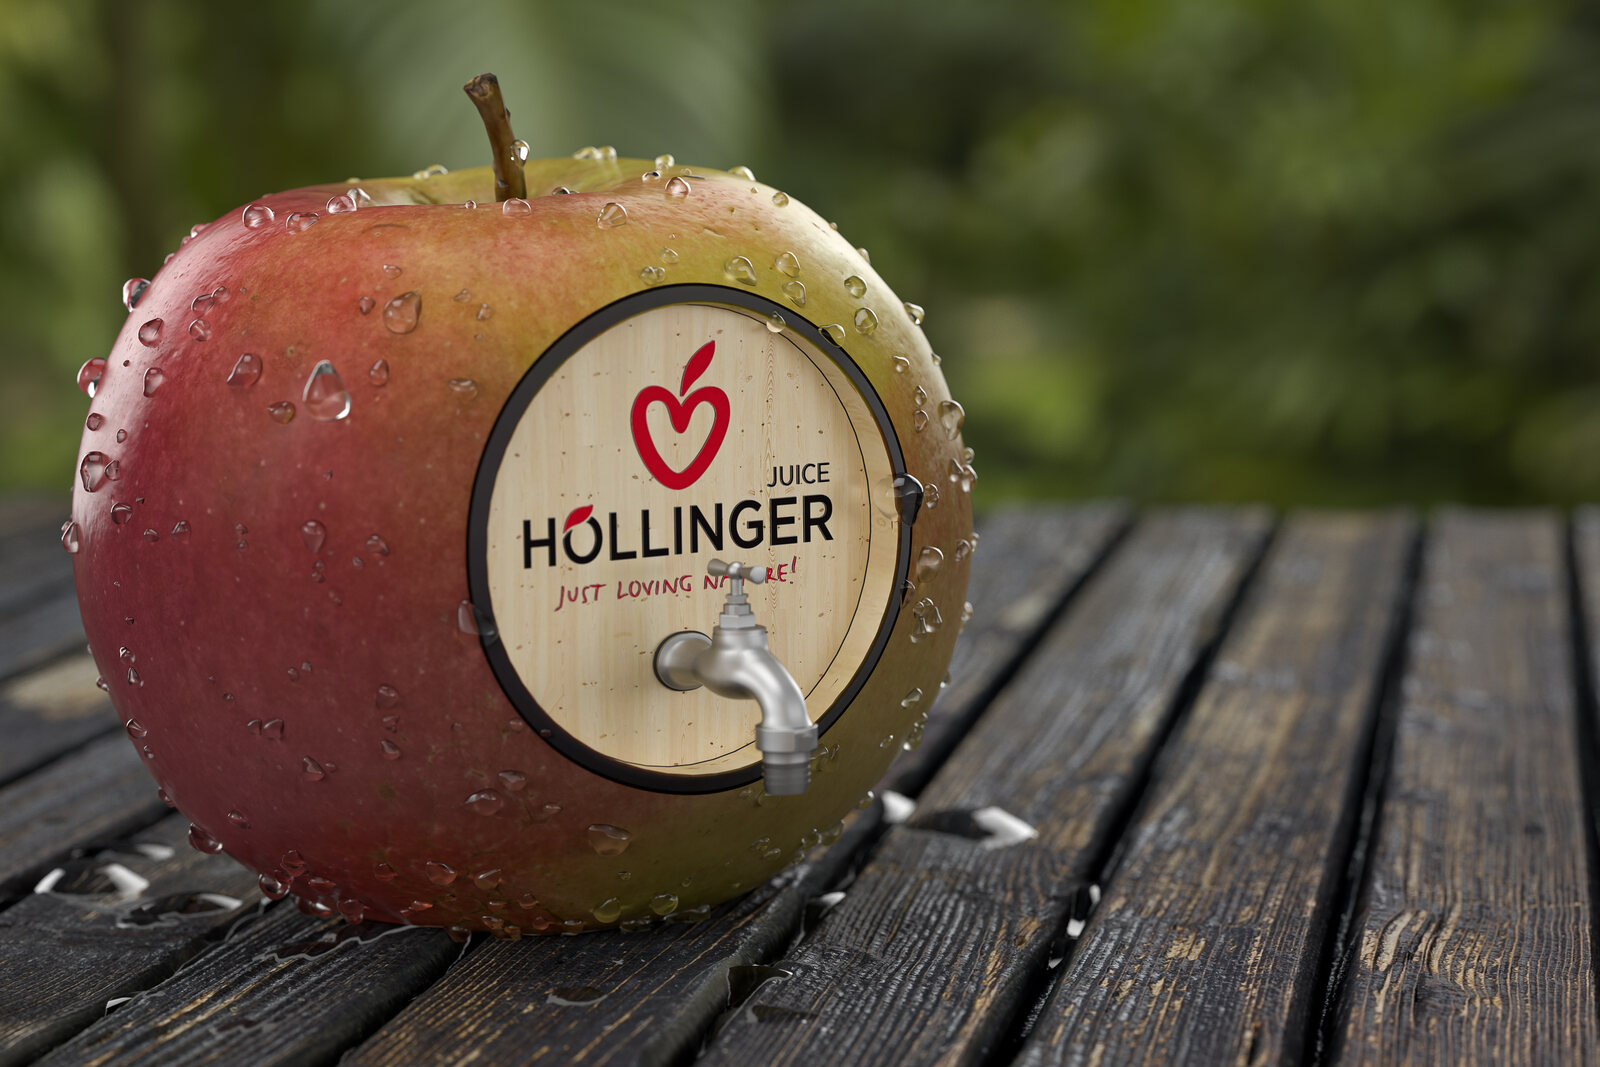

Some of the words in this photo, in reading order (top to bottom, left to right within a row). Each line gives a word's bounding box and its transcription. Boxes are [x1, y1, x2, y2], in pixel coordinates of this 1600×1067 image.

[767, 462, 830, 487] JUICE
[554, 584, 607, 611] JUST
[617, 575, 692, 600] LOVING
[704, 556, 797, 589] NRE!
